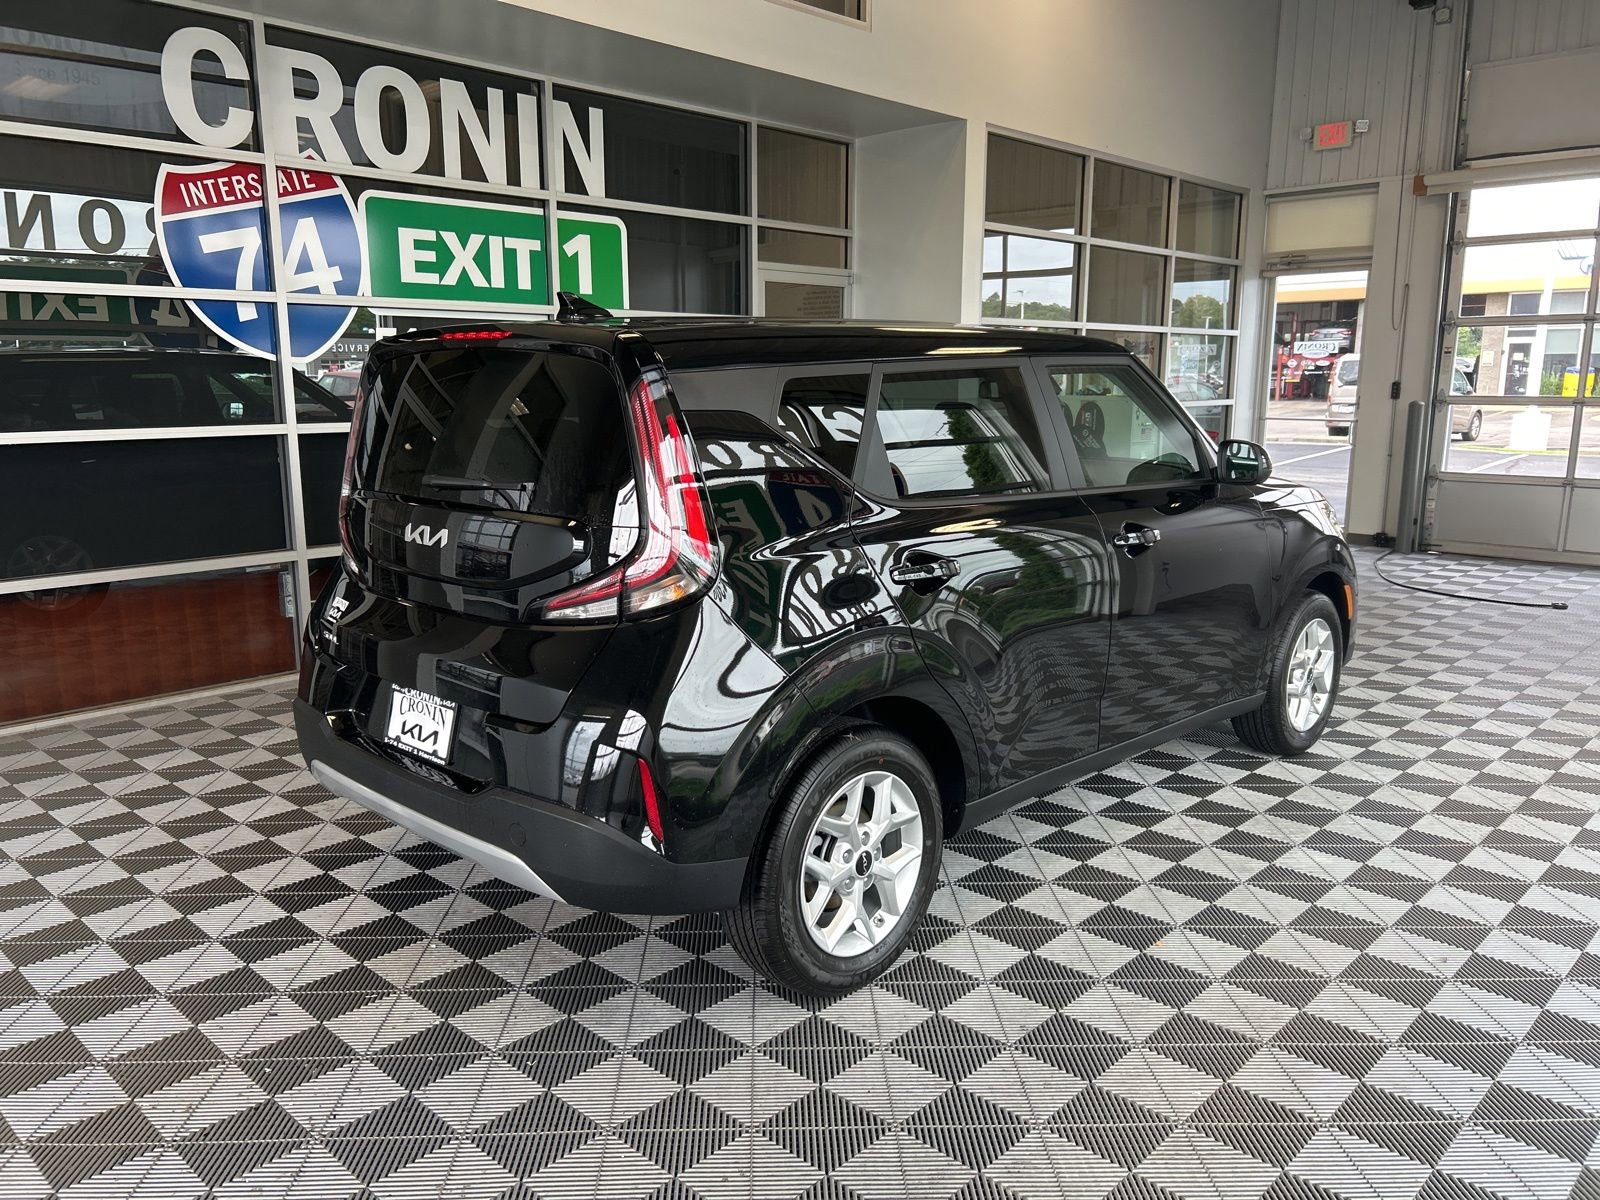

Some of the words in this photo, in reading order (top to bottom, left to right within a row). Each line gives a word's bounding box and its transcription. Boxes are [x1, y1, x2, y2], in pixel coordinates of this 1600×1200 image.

[160, 26, 606, 198] CRONIN
[1319, 123, 1348, 147] EXIT
[179, 169, 316, 208] INTERSATE
[199, 216, 342, 322] 74
[397, 227, 541, 290] EXIT
[562, 234, 593, 295] 1
[405, 522, 448, 549] KIA
[400, 696, 447, 731] CRONIN
[401, 720, 439, 747] KIA
